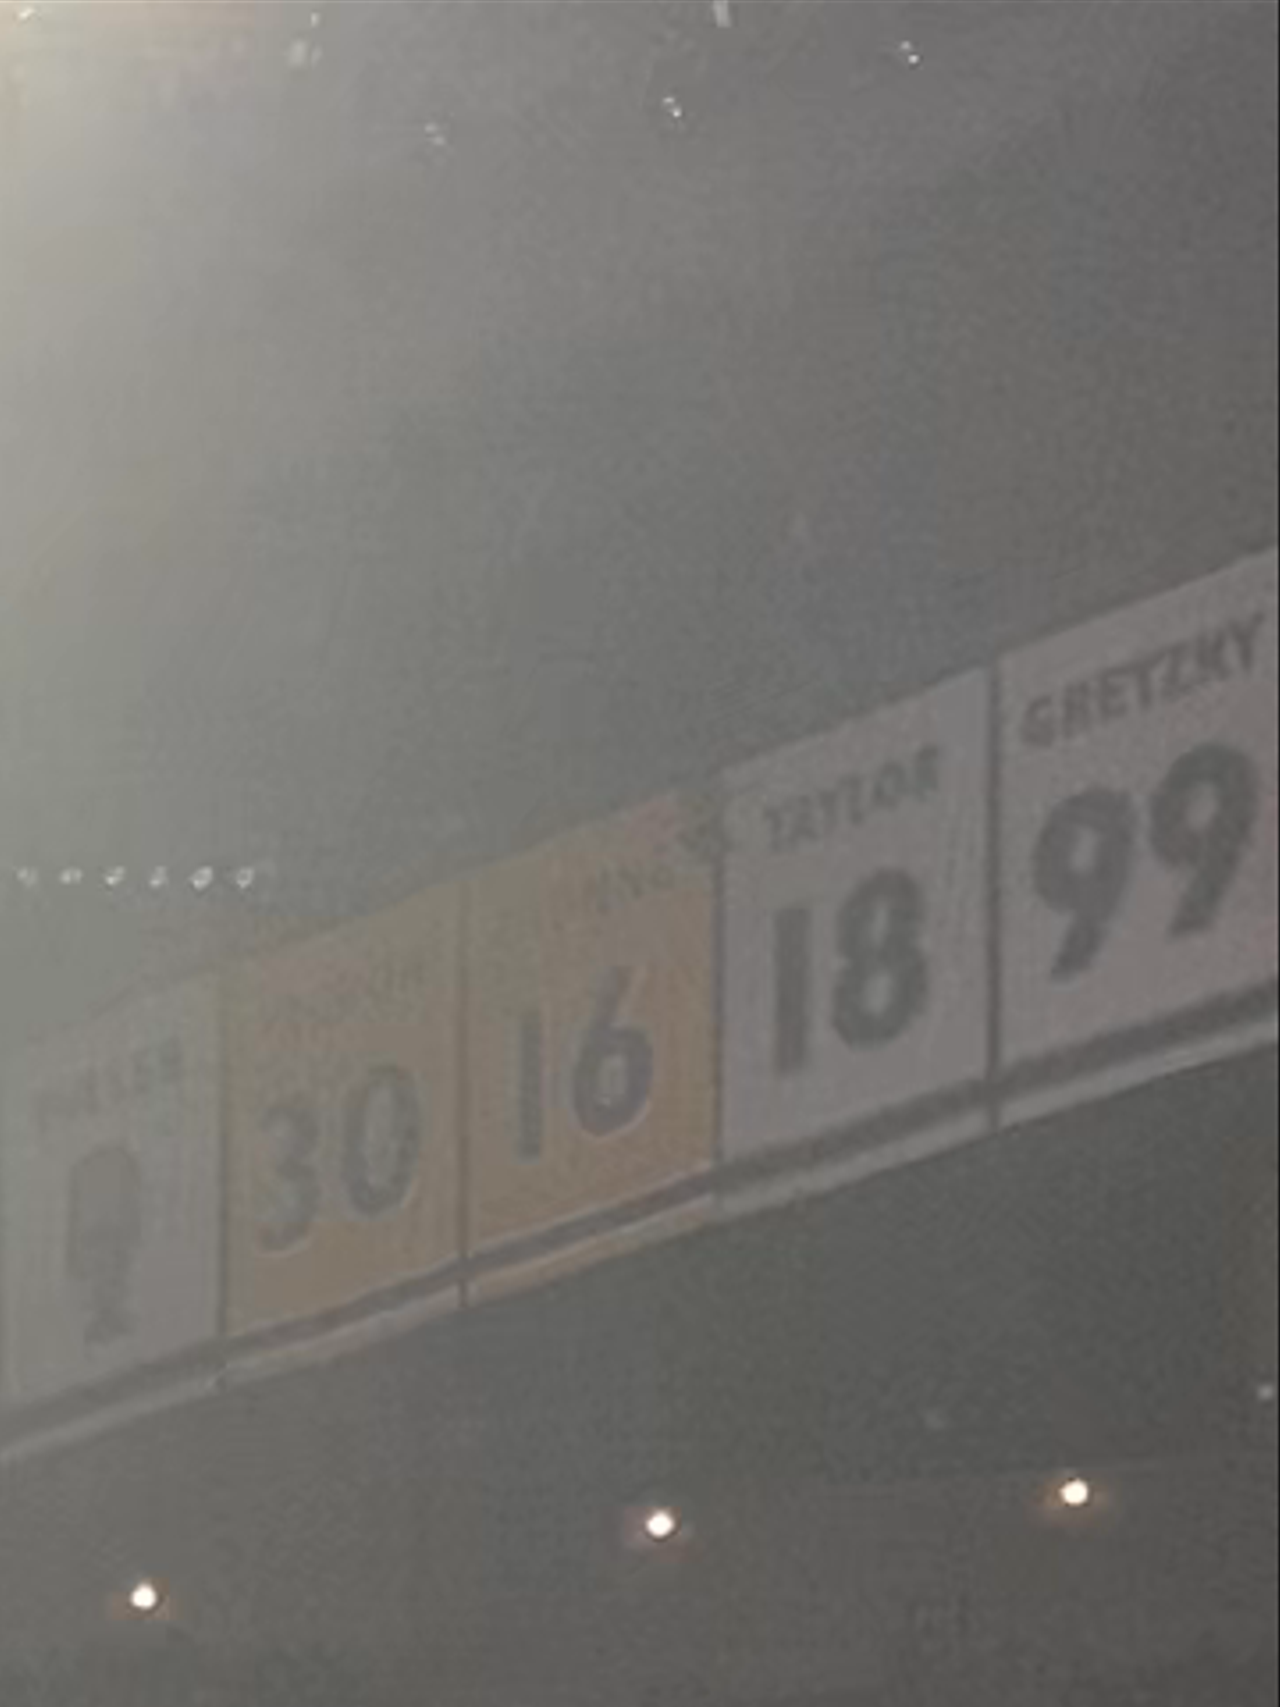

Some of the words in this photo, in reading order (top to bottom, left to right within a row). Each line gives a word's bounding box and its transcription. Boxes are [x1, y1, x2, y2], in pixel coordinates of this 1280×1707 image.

[1021, 608, 1265, 748] GRETZKY
[1034, 742, 1264, 984] 99
[518, 965, 654, 1166] 16
[772, 866, 930, 1080] 18
[258, 1065, 423, 1256] 30
